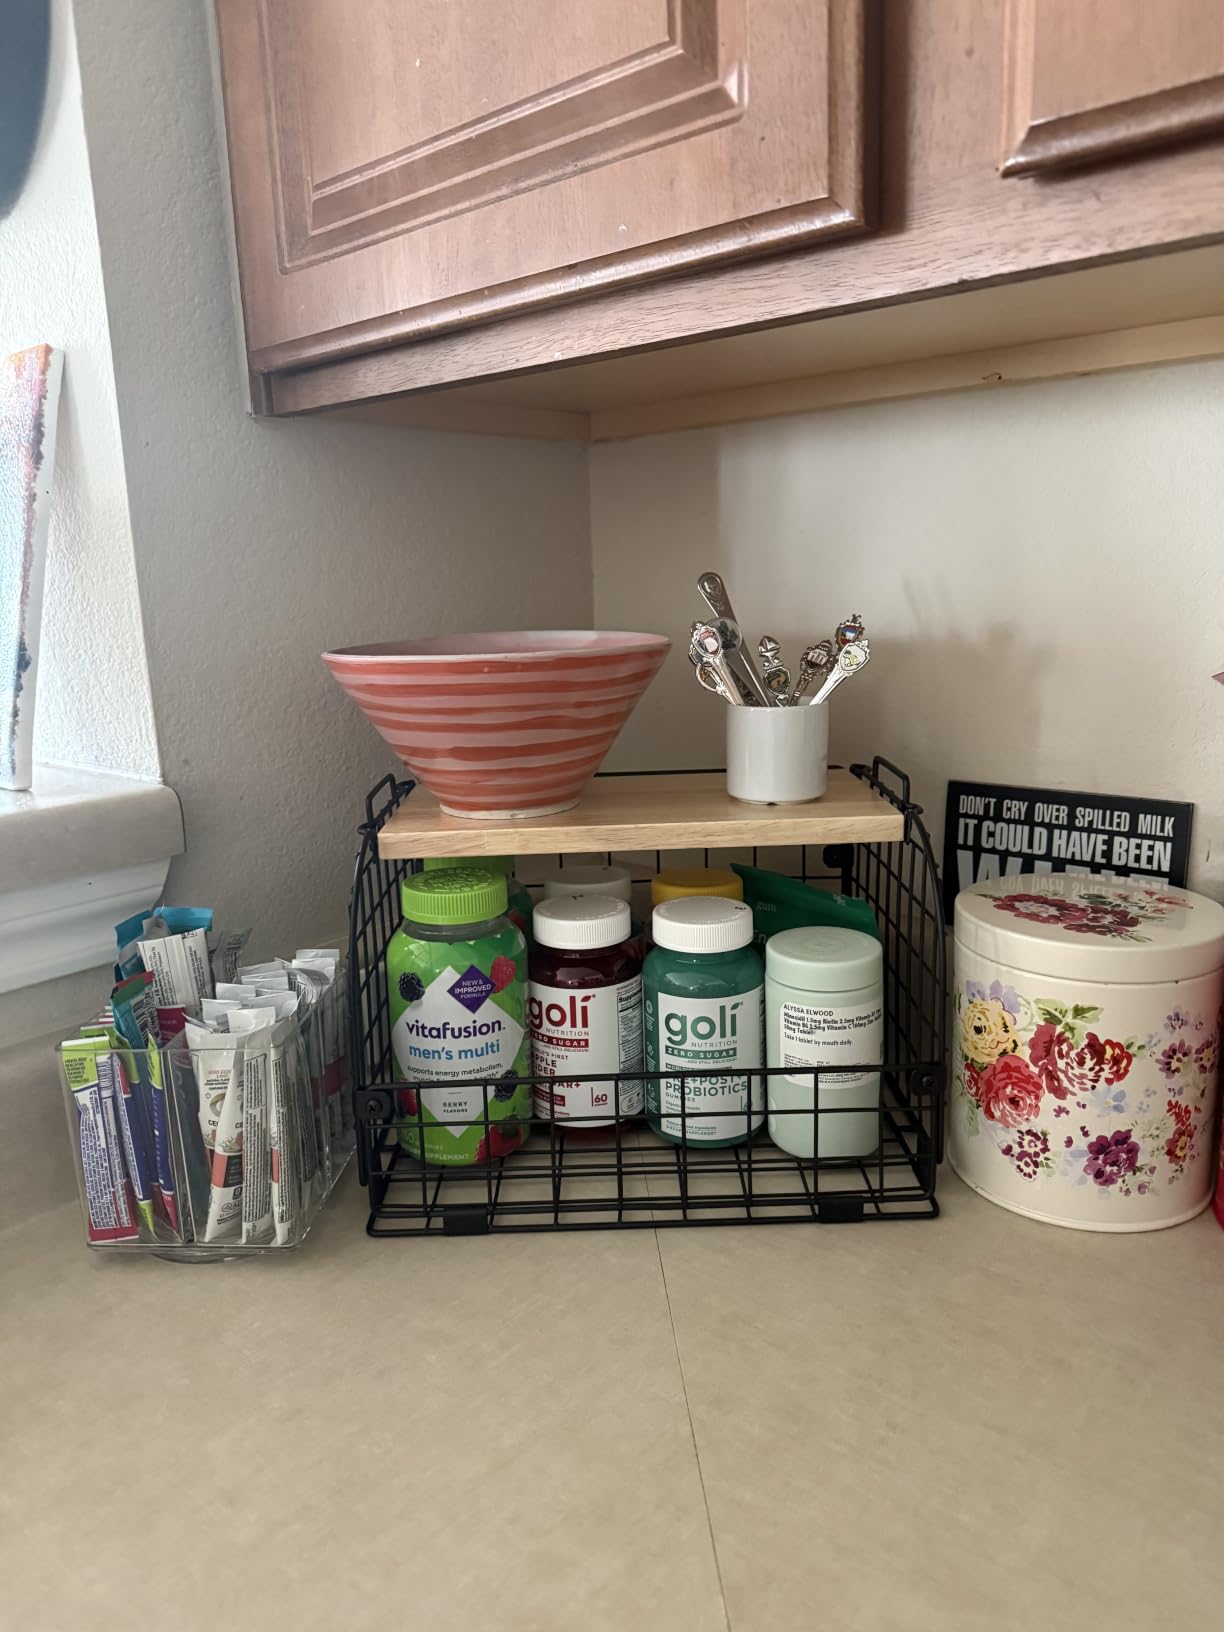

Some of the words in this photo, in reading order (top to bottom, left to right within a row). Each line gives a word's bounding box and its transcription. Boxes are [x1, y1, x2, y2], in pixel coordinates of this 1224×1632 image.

[959, 795, 996, 817] DON'T
[1002, 799, 1028, 820] CRY
[1034, 802, 1068, 826] OVER
[1075, 807, 1130, 832] SPILLED
[1137, 813, 1175, 838] MILK
[957, 817, 978, 845] IT
[981, 820, 1048, 856] COULD
[1052, 829, 1108, 864] HAVE
[1112, 836, 1172, 873] BEEN
[454, 984, 492, 995] IMPROVED
[784, 1004, 805, 1014] ALYSSA
[806, 1008, 834, 1017] ELWOOD
[664, 1001, 740, 1047] goli
[545, 1028, 590, 1037] NUTRITION
[552, 1038, 586, 1047] SUGAR
[691, 1039, 738, 1048] NUTRITION
[408, 1043, 455, 1061] men's
[457, 1039, 501, 1061] multi
[667, 1047, 694, 1057] ZERO
[700, 1050, 734, 1059] SUGAR
[535, 1053, 558, 1068] PPLE
[406, 1064, 435, 1077] supports
[434, 1069, 460, 1078] energy
[594, 1093, 608, 1103] 60
